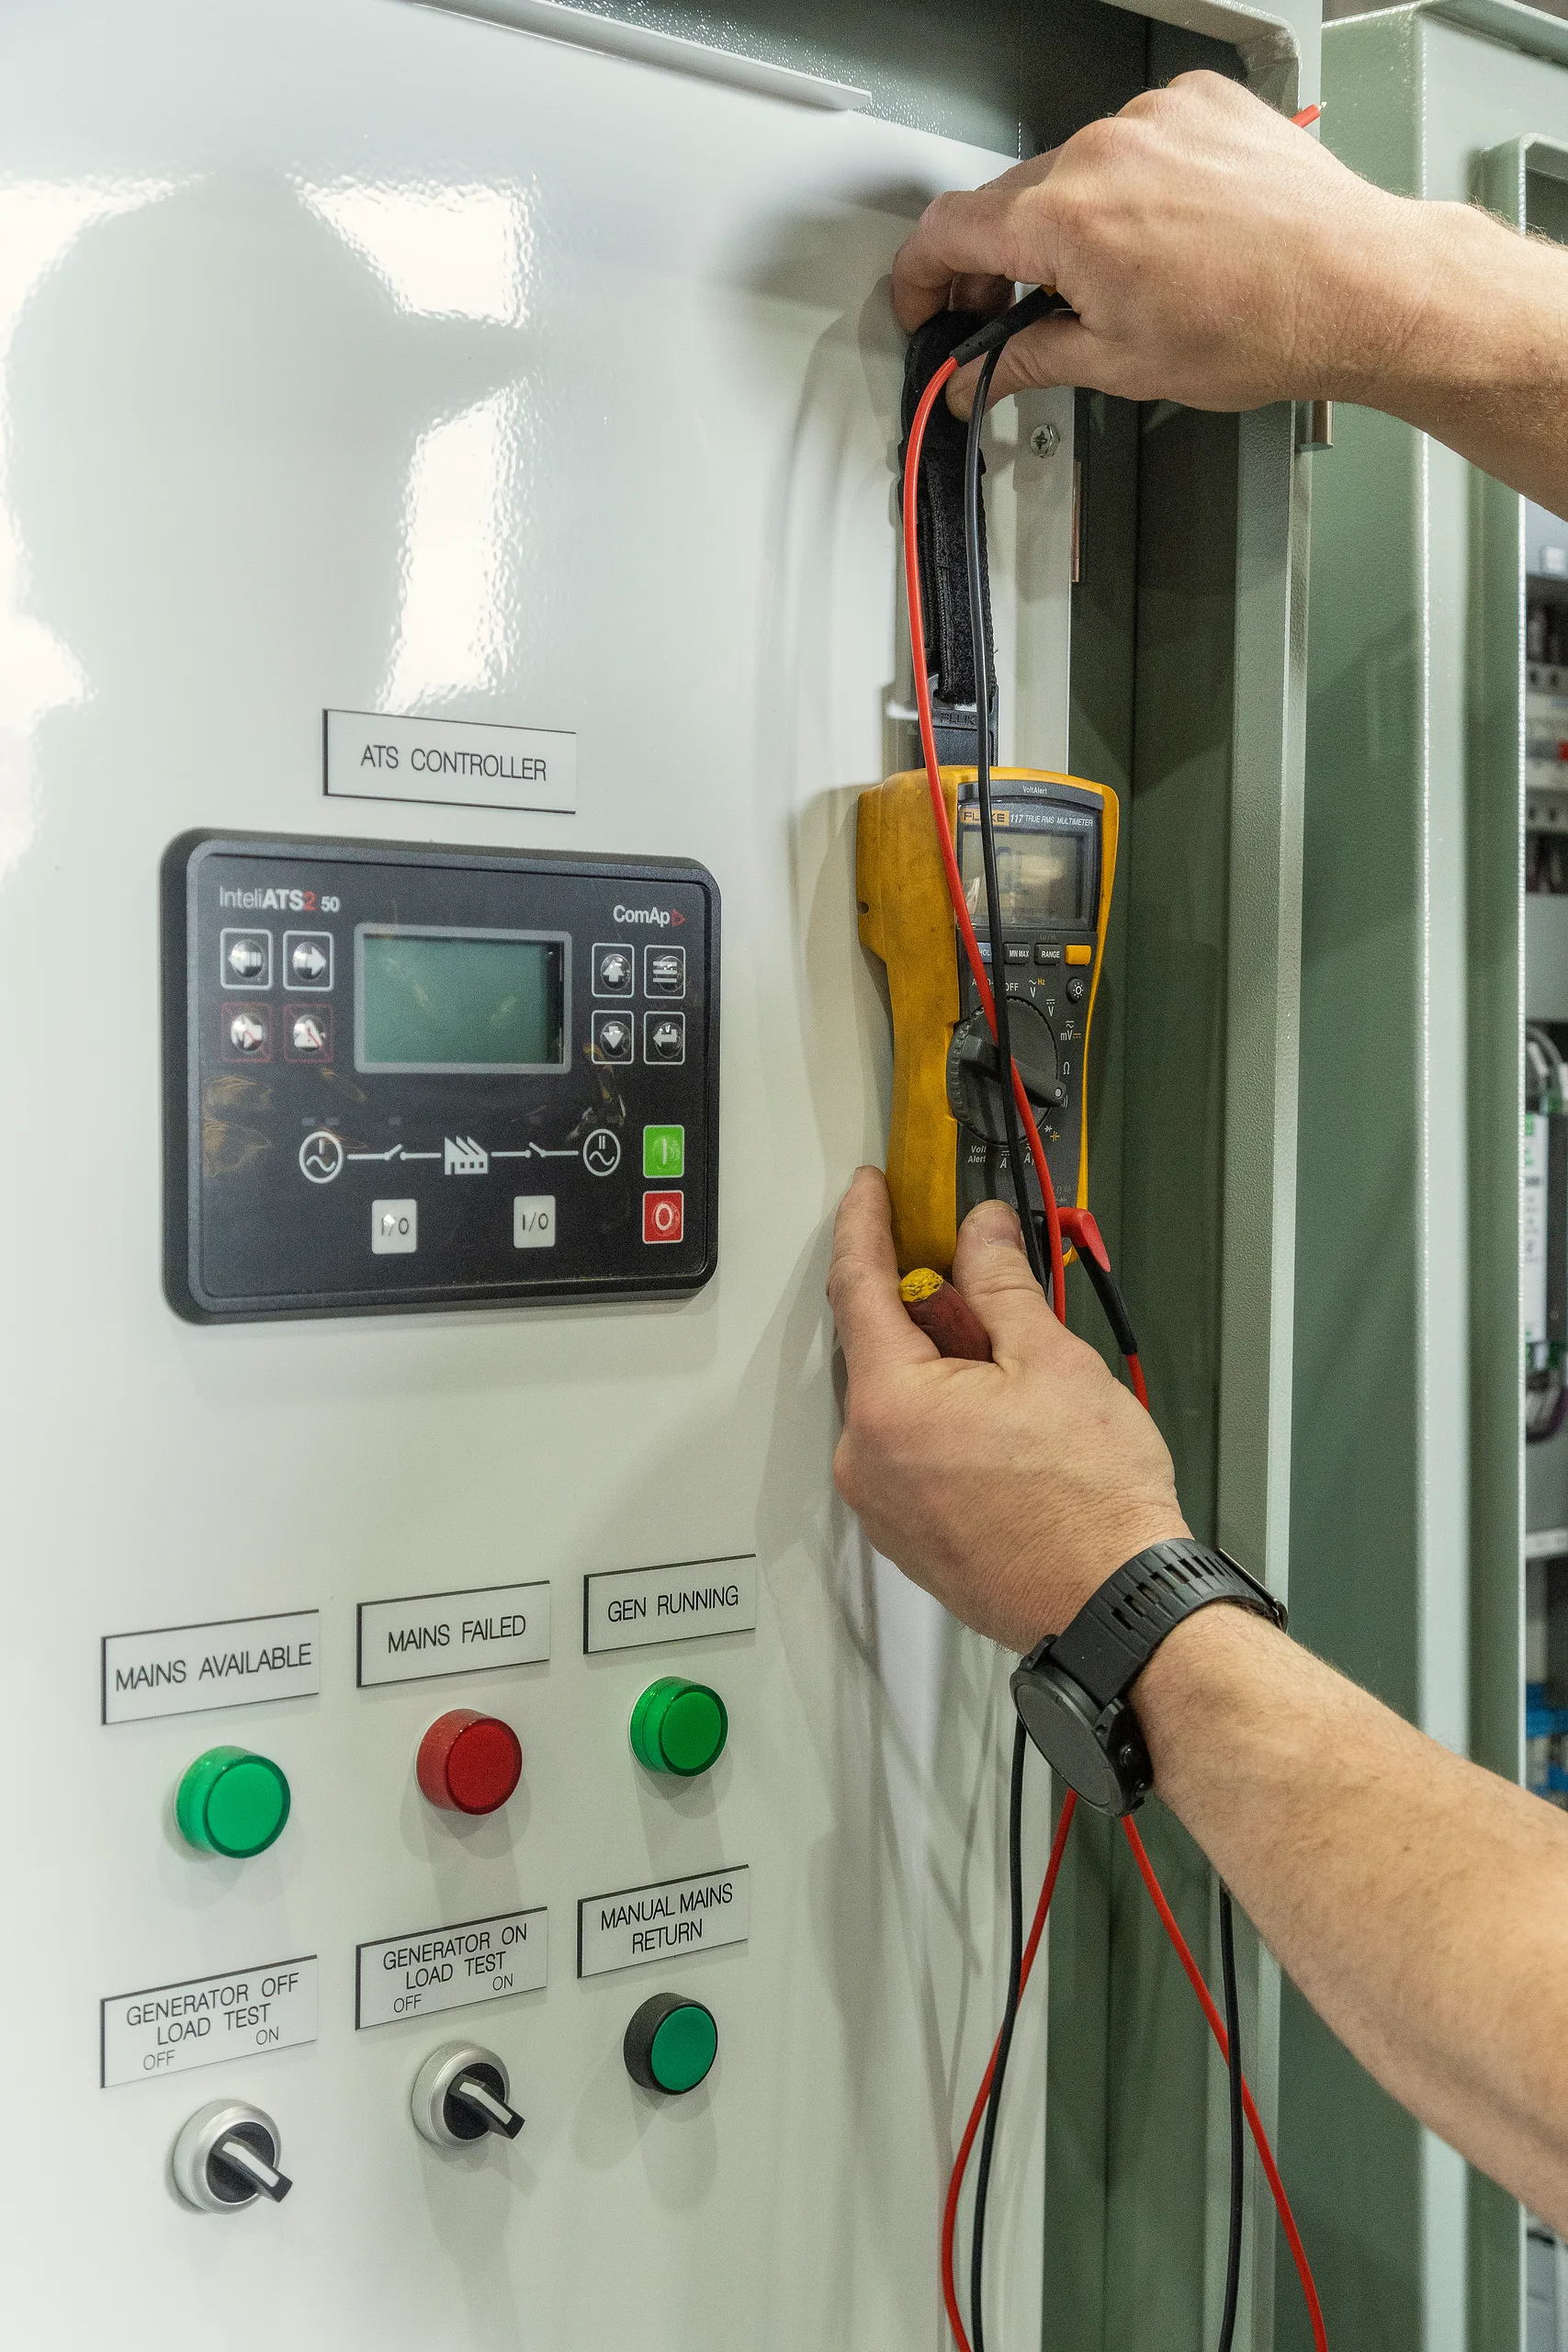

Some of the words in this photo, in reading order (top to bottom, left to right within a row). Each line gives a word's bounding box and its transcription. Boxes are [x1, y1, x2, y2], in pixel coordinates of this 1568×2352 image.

[941, 712, 976, 726] FLUK
[361, 745, 399, 769] ATS
[412, 751, 547, 782] CONTROLLER
[1022, 785, 1048, 795] VoltAlert
[964, 811, 1006, 823] FLKE
[1010, 813, 1023, 823] 117
[1025, 814, 1041, 823] TRUE
[1041, 815, 1055, 824] RMS
[1056, 817, 1094, 827] MULTIMETER
[321, 896, 341, 913] 50
[613, 904, 671, 928] ComAp
[978, 948, 992, 957] HOL
[1019, 950, 1030, 958] MAX
[1041, 950, 1061, 958] RANGE
[1005, 982, 1019, 991] OFF
[1037, 978, 1046, 986] Hz
[967, 1155, 987, 1163] Alert
[971, 1145, 987, 1154] Volt
[607, 1597, 647, 1623] GEN
[657, 1585, 739, 1617] RUNNING
[388, 1623, 451, 1654] MAINS
[462, 1614, 526, 1645] FAILED
[115, 1659, 186, 1692] MAINS
[198, 1643, 312, 1681] AVAILABLE
[601, 1895, 675, 1931] MANUAL
[680, 1883, 733, 1915] MAINS
[383, 1930, 491, 1971] GENERATOR
[501, 1923, 528, 1947] ON
[632, 1918, 704, 1955] RETURN
[405, 1963, 454, 1991] LOAD
[463, 1951, 507, 1978] TEST
[126, 1983, 249, 2027] GENERATOR
[261, 1972, 299, 1998] OFF
[393, 1994, 423, 2014] OFF
[491, 1973, 514, 1992] ON
[156, 2017, 211, 2047] LOAD
[223, 2003, 272, 2031] TEST
[142, 2049, 175, 2071] OFF
[255, 2026, 280, 2046] ON
